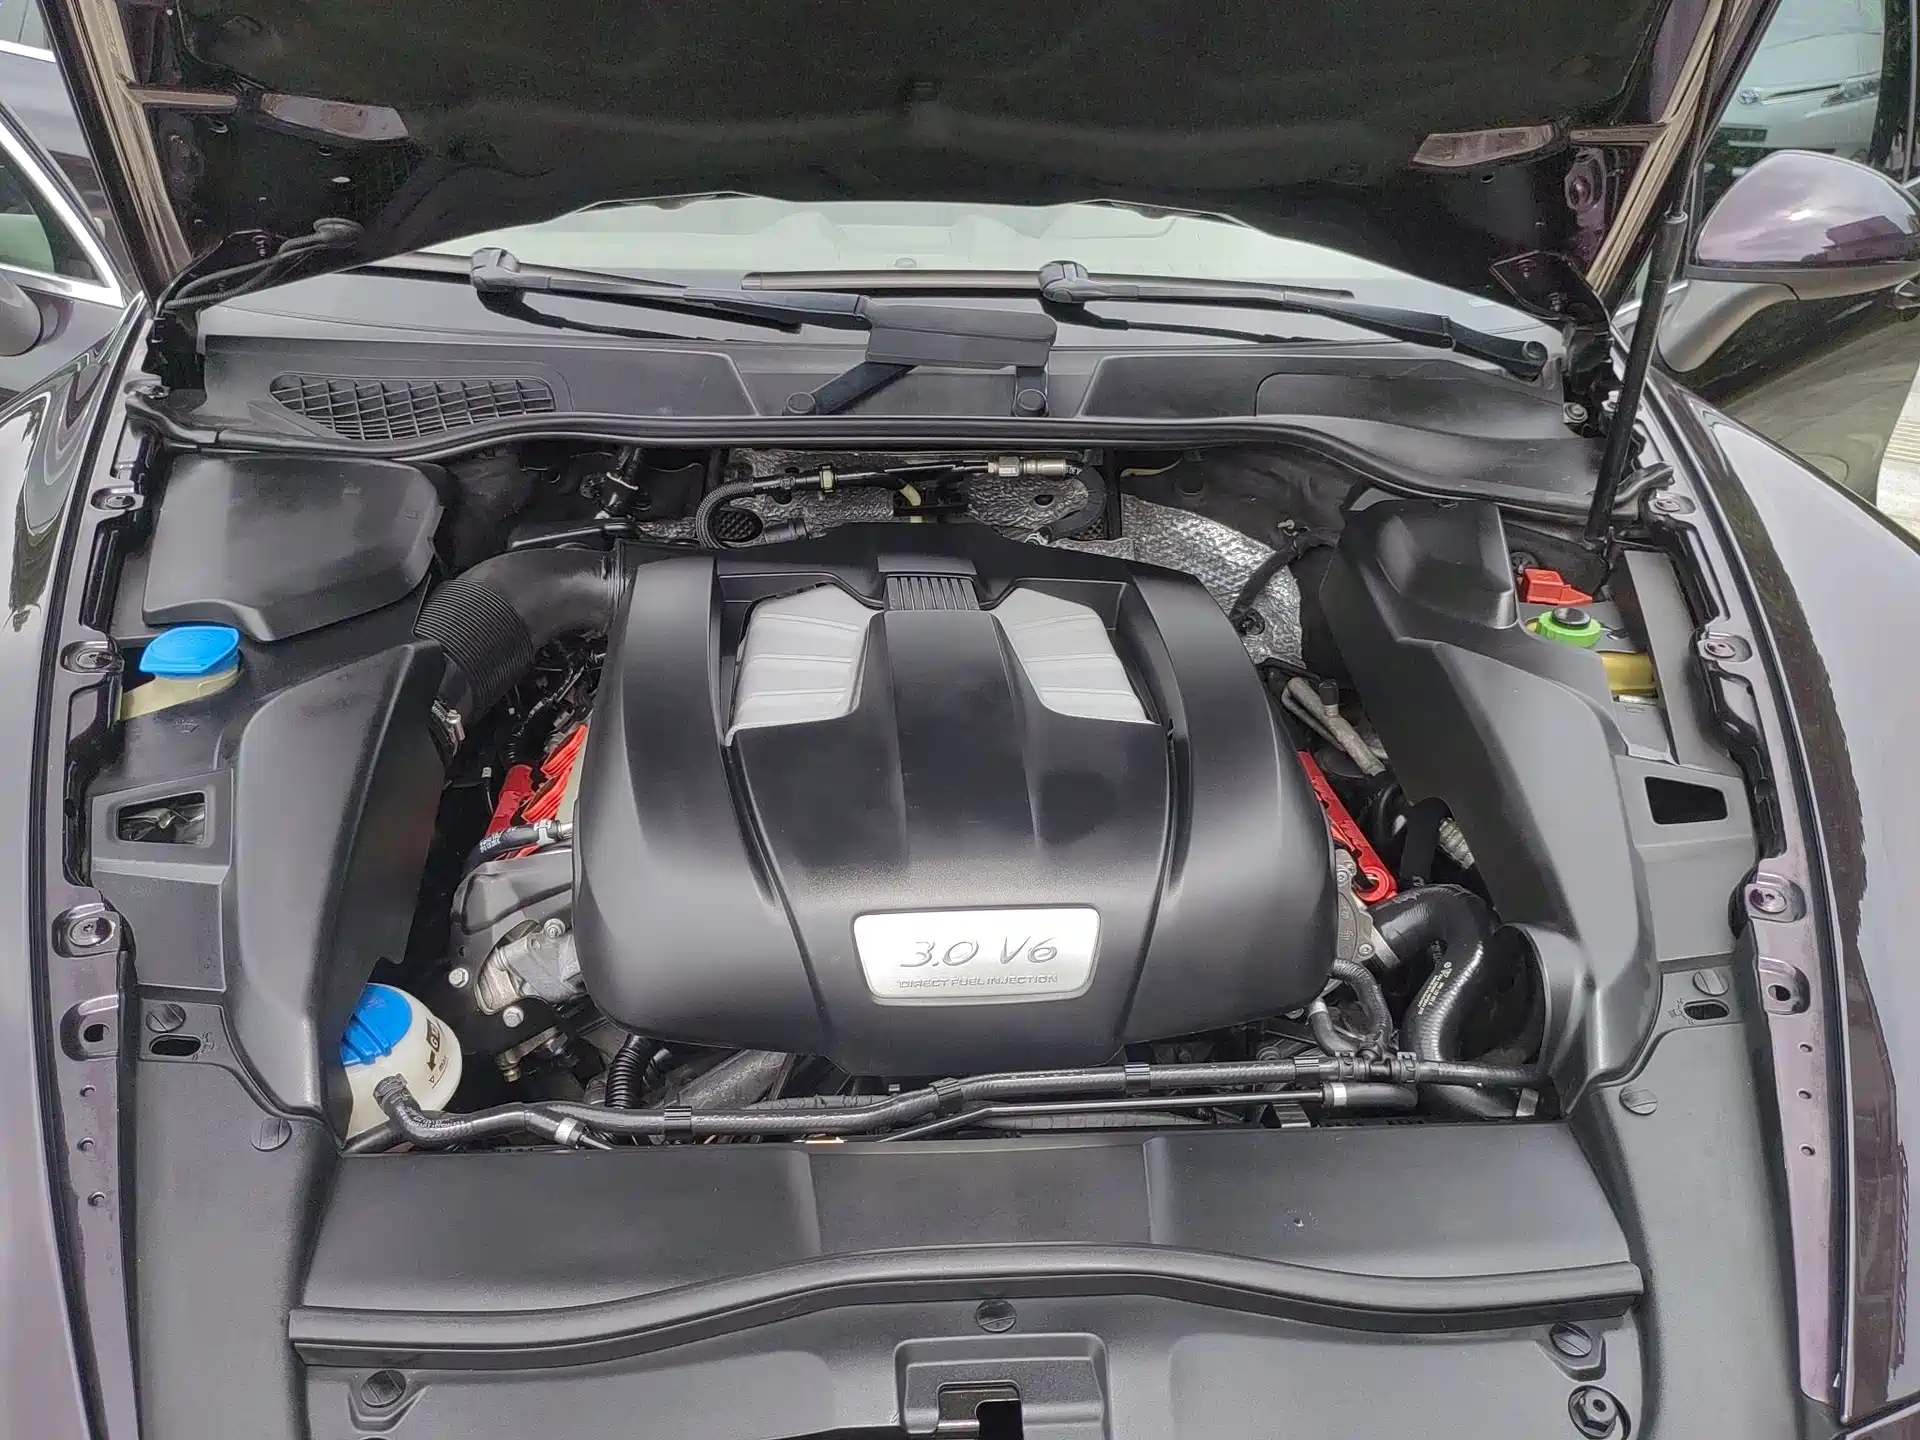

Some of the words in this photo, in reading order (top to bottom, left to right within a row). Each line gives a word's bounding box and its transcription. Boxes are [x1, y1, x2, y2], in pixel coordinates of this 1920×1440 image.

[899, 940, 979, 967] 3.0
[1000, 936, 1058, 964] V6
[899, 978, 949, 989] DIRECT
[951, 976, 986, 987] FUEL
[986, 974, 1058, 986] INJECTION
